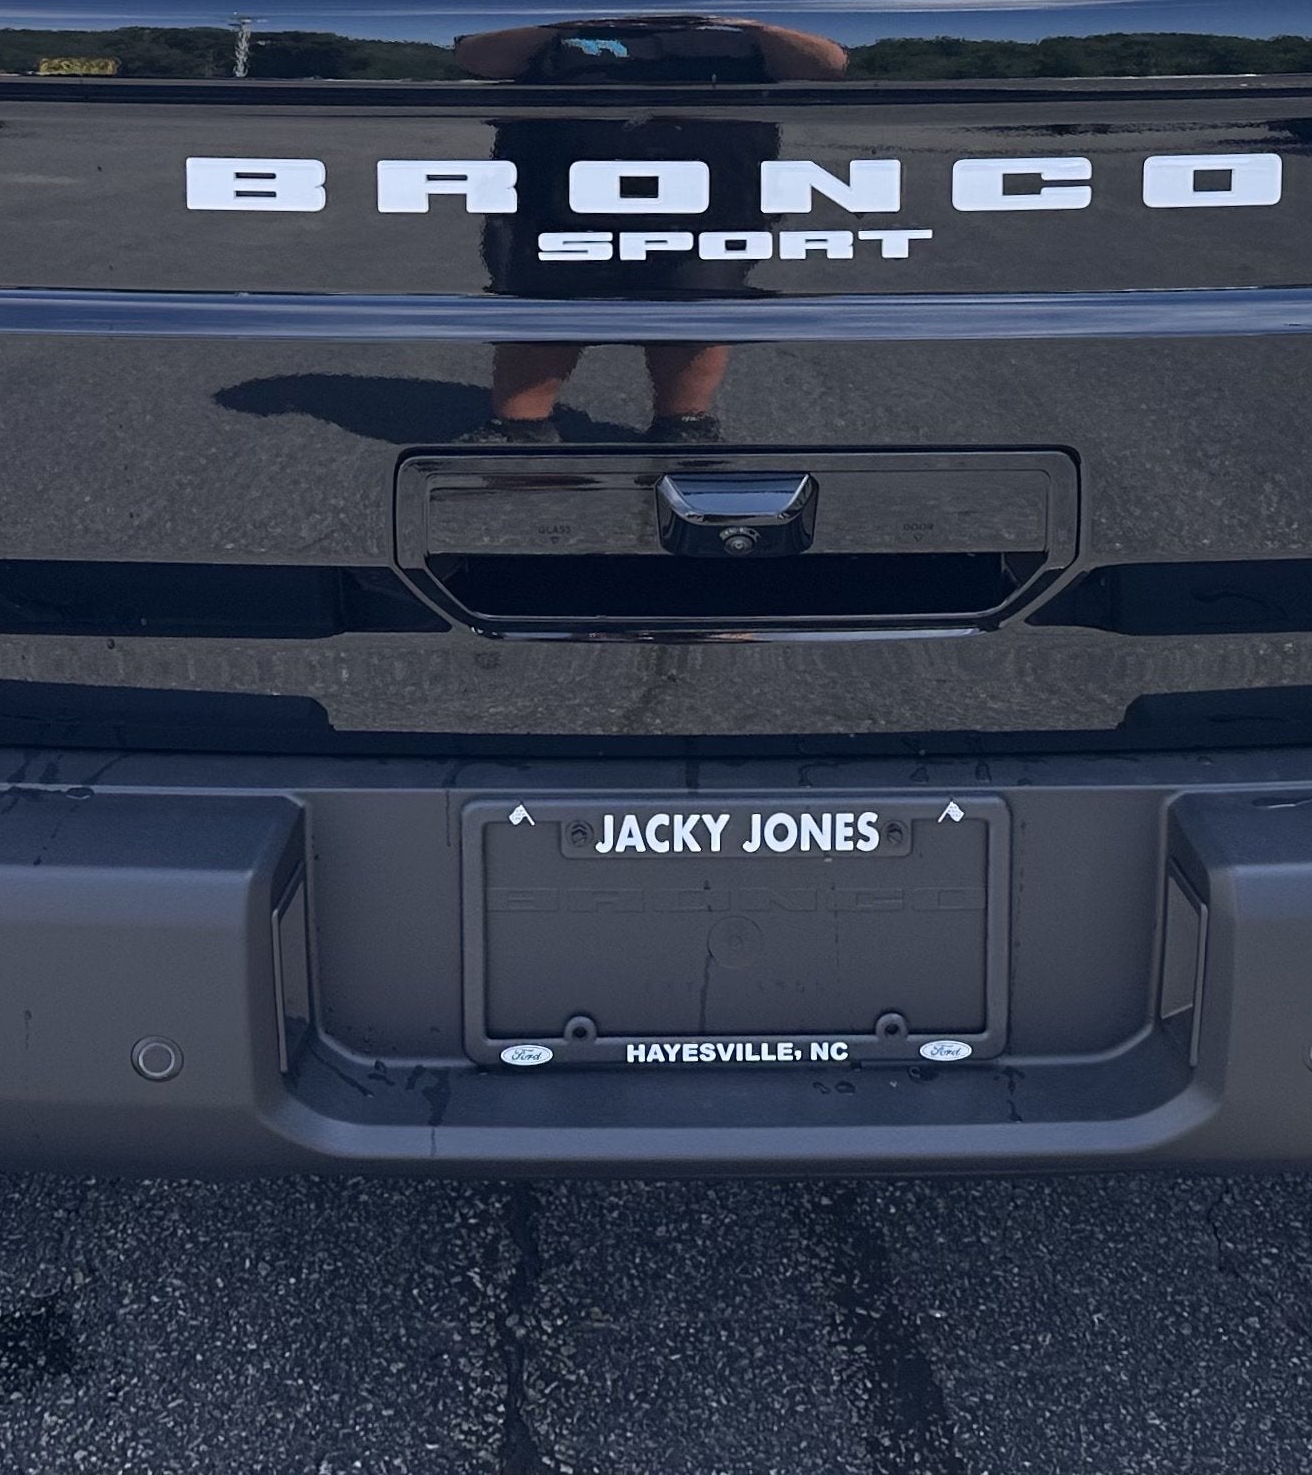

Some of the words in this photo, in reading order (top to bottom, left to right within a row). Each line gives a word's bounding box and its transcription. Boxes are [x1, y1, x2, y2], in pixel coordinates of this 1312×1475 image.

[186, 153, 1282, 214] BRONCO
[538, 229, 933, 261] SPORT
[595, 813, 731, 854] JACKY
[742, 811, 880, 853] JONES
[486, 887, 987, 913] BRONCO
[511, 1048, 543, 1061] Ford
[626, 1042, 802, 1063] HAYESVILLE,
[810, 1041, 849, 1061] NC
[930, 1044, 962, 1057] Ford
